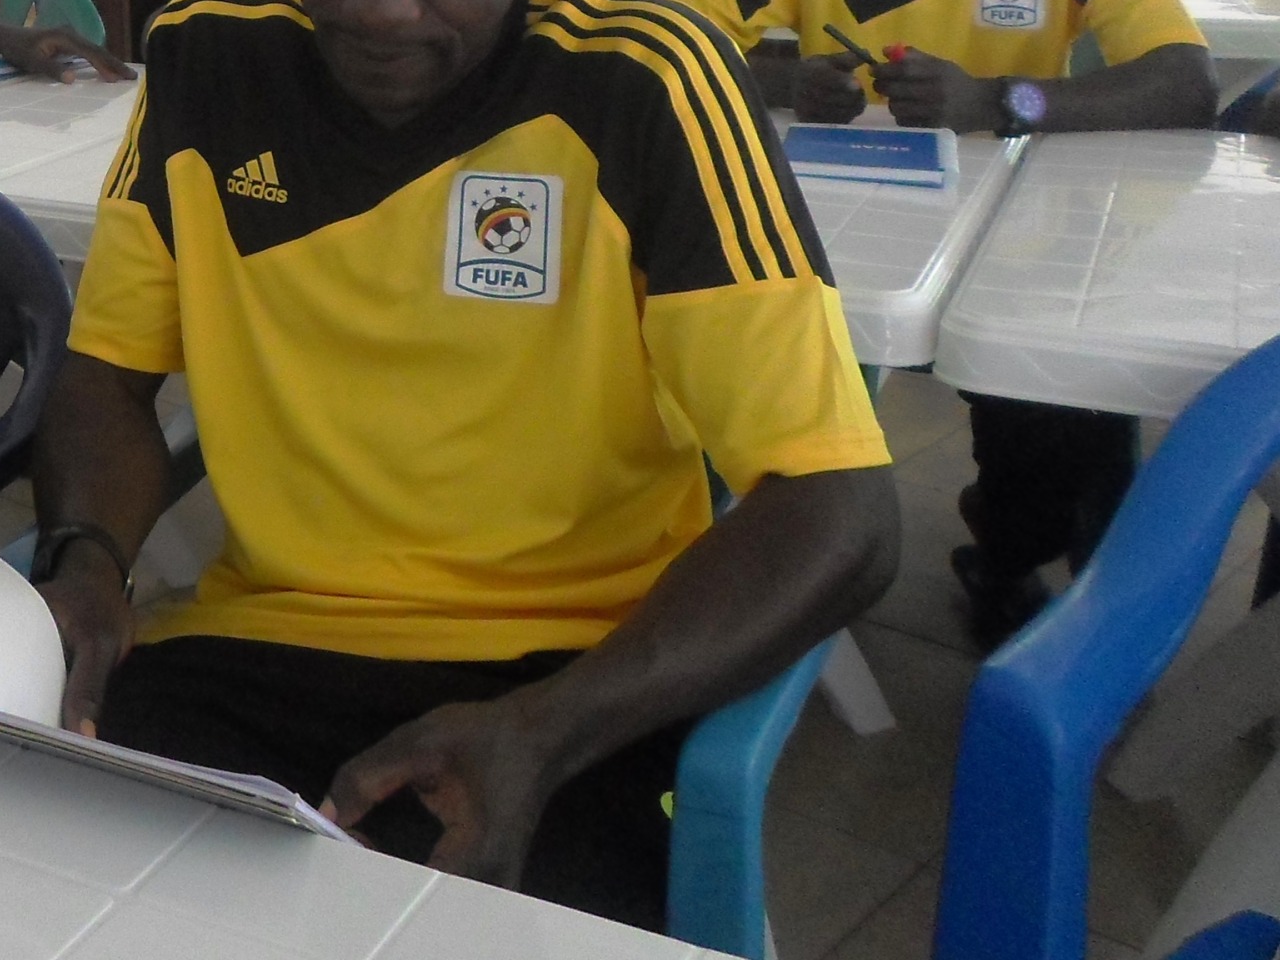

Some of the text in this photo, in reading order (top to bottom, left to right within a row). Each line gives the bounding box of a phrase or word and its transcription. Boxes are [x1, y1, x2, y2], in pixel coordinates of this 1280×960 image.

[990, 10, 1025, 20] FUFA
[227, 177, 289, 204] adidas
[472, 268, 529, 288] FUFA
